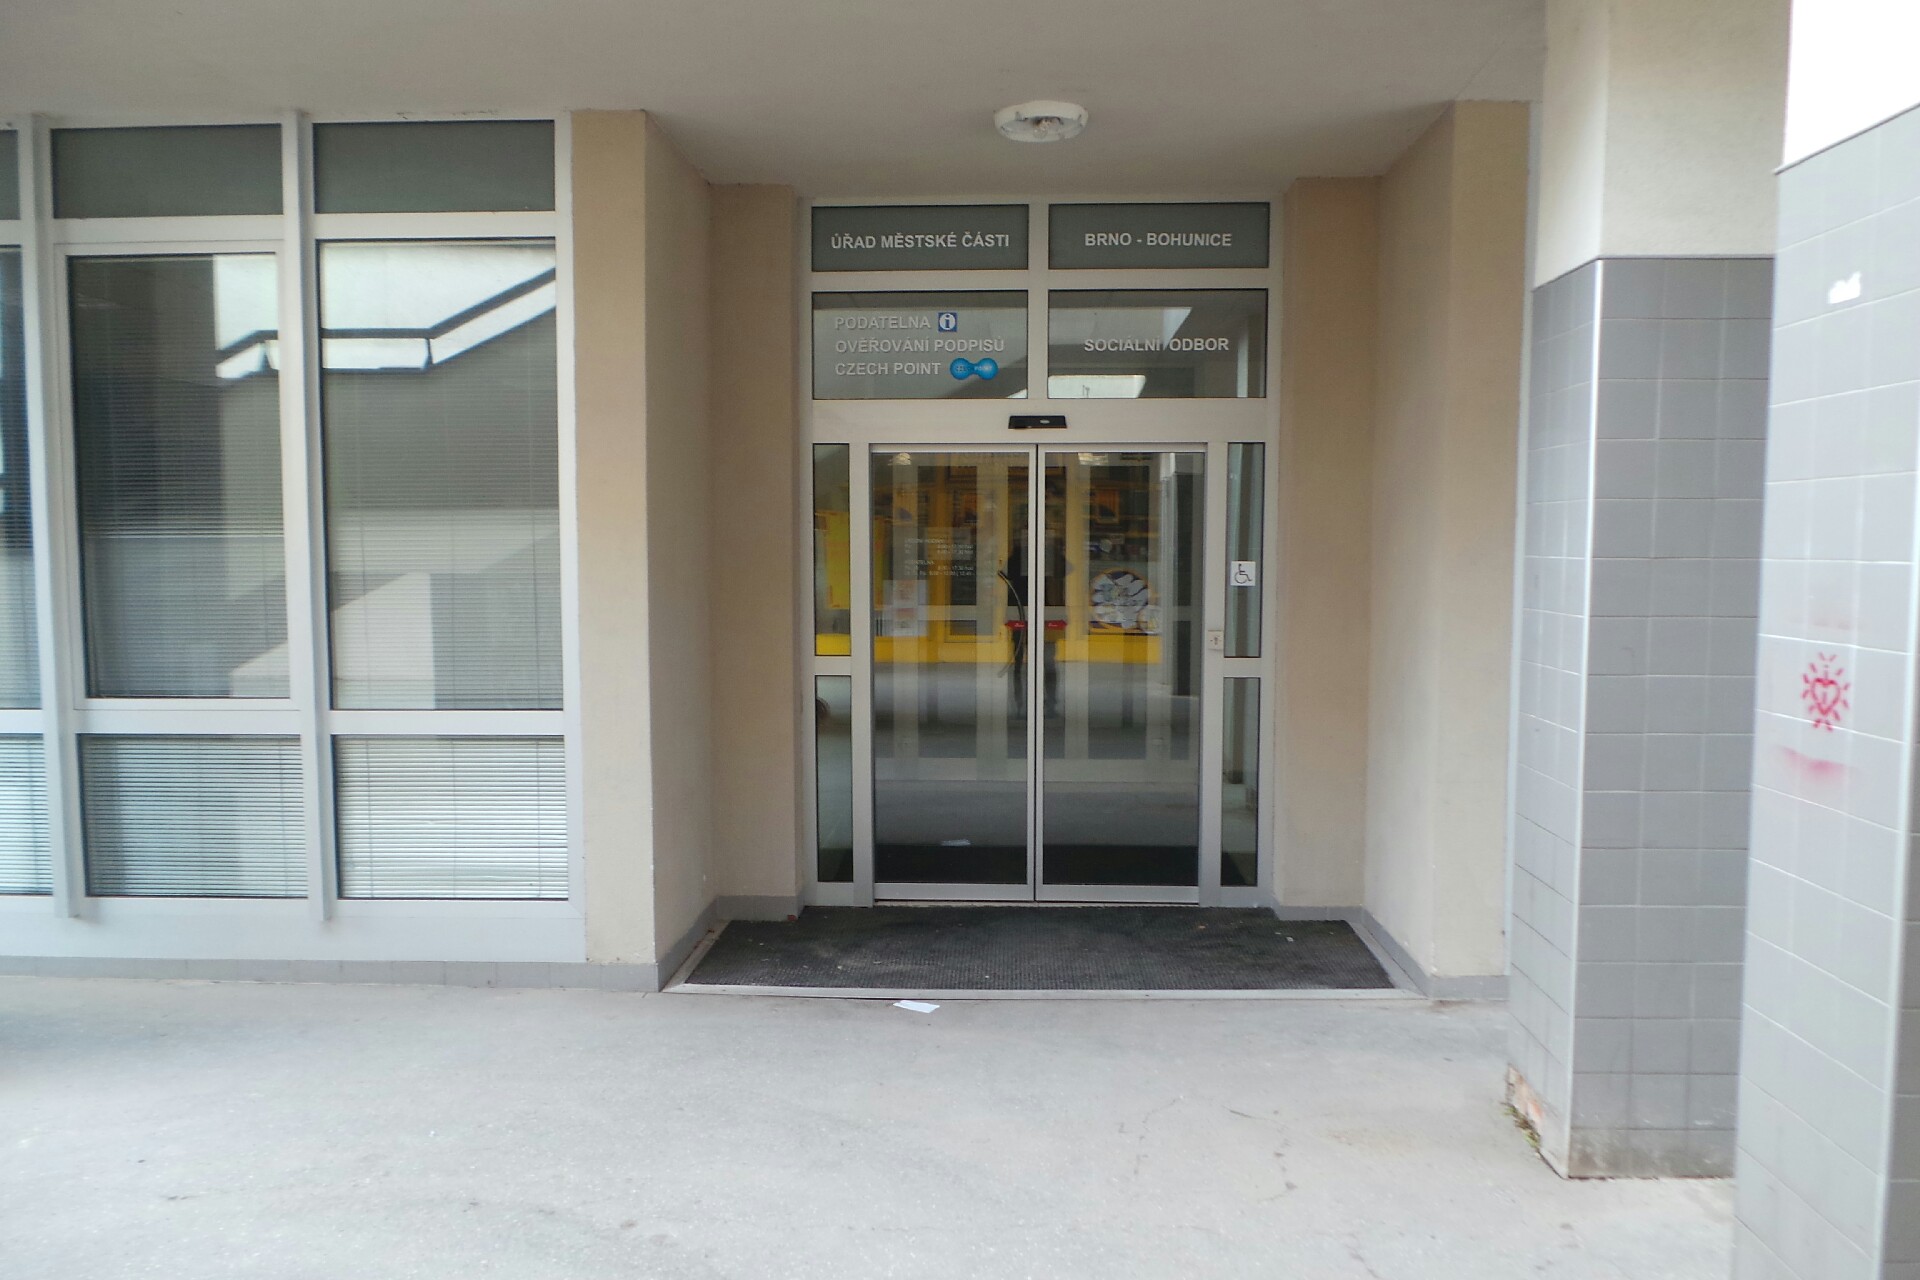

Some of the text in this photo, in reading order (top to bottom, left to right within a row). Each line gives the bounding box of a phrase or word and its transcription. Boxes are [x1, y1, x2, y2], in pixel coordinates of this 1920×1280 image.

[831, 231, 1010, 249] ÚŘAD MĚSTSKÉ ČÁSTI
[1085, 233, 1132, 246] BRNO
[1146, 232, 1232, 246] BOHUNICE
[835, 316, 931, 330] PODATELNA
[835, 337, 929, 353] OVĚŘOVÁNÍ
[1084, 336, 1229, 351] SOCIÁLNÍ ODBOR
[835, 362, 889, 376] CZECH
[893, 362, 941, 375] POINT
